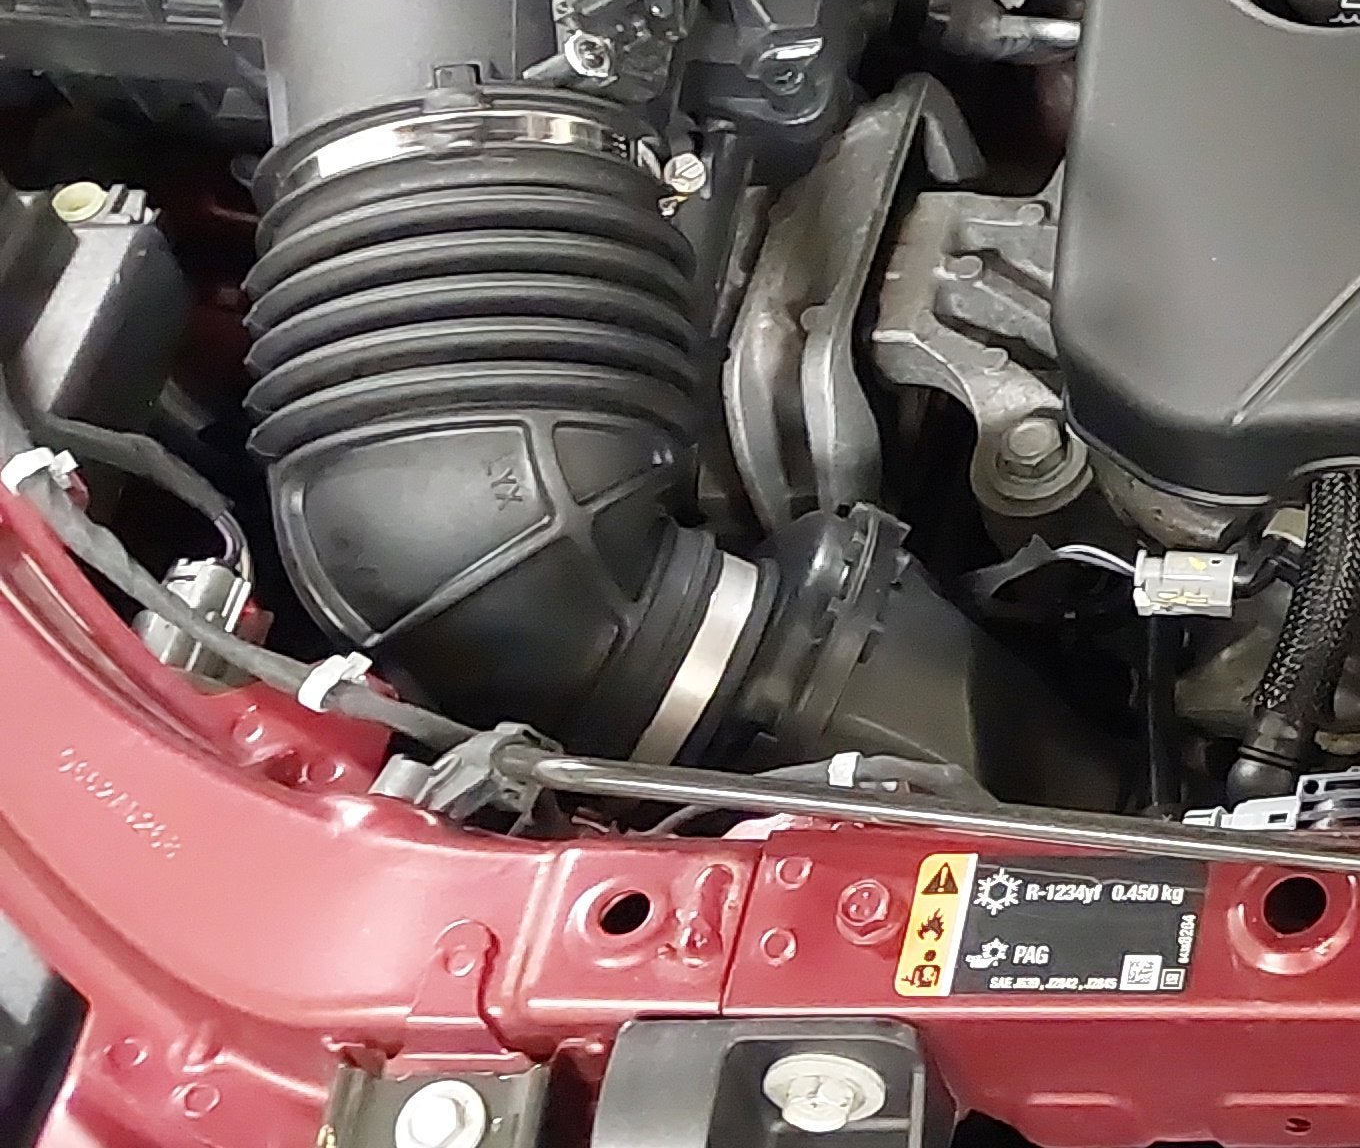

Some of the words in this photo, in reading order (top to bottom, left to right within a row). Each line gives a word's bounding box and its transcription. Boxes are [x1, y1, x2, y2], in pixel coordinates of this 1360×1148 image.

[1024, 883, 1103, 905] R-1234yf
[1111, 883, 1158, 901] 0.450
[1160, 882, 1184, 905] kg
[1012, 945, 1050, 965] PAG
[989, 976, 1013, 990] SAE
